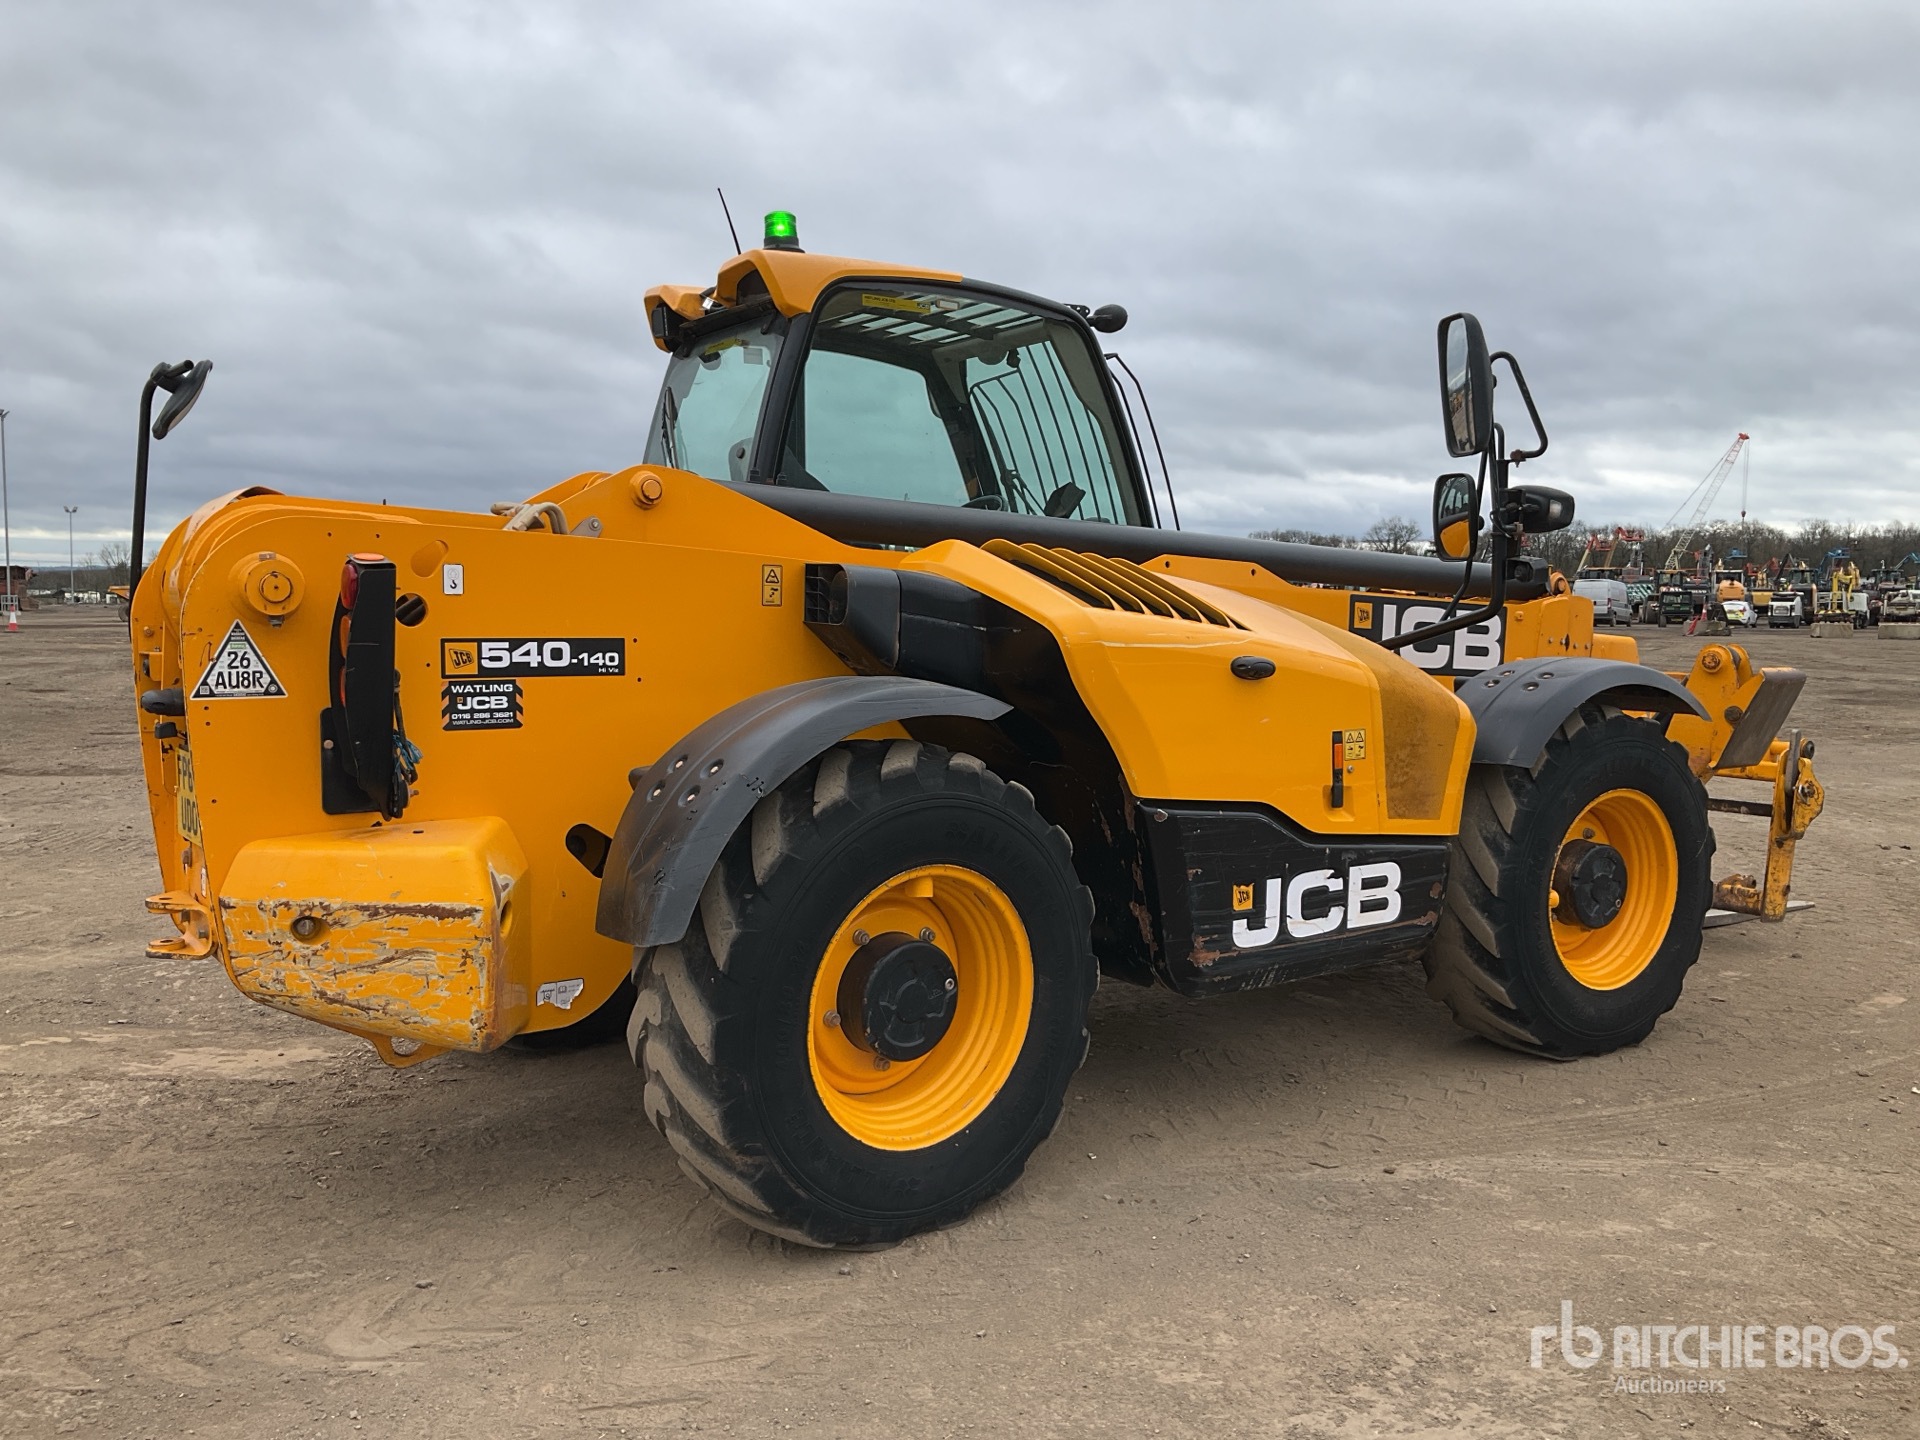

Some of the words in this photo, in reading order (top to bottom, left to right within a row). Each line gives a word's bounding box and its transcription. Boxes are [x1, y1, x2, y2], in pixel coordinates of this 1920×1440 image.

[227, 651, 251, 669] 26
[452, 649, 473, 667] JCB
[480, 641, 619, 668] 540-140
[214, 671, 265, 690] AU8R
[451, 683, 514, 693] WATLING
[457, 695, 509, 710] JCB
[452, 718, 514, 726] WATLING-JCB.COM
[1232, 861, 1402, 948] JCB
